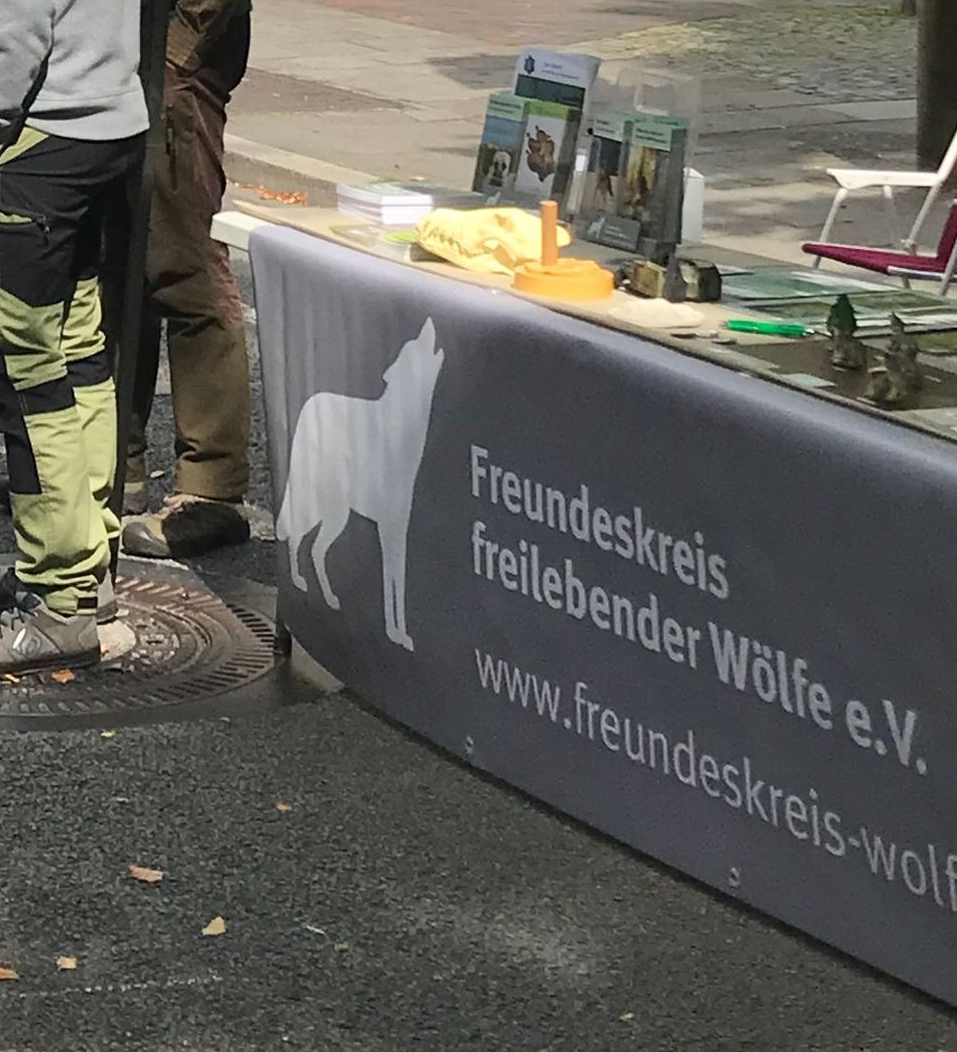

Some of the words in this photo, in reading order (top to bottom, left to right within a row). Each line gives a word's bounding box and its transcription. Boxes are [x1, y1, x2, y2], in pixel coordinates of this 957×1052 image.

[470, 444, 731, 600] Freundeskreis
[471, 520, 702, 670] freilebender
[707, 621, 834, 731] Wölfe
[845, 696, 928, 776] e.V.
